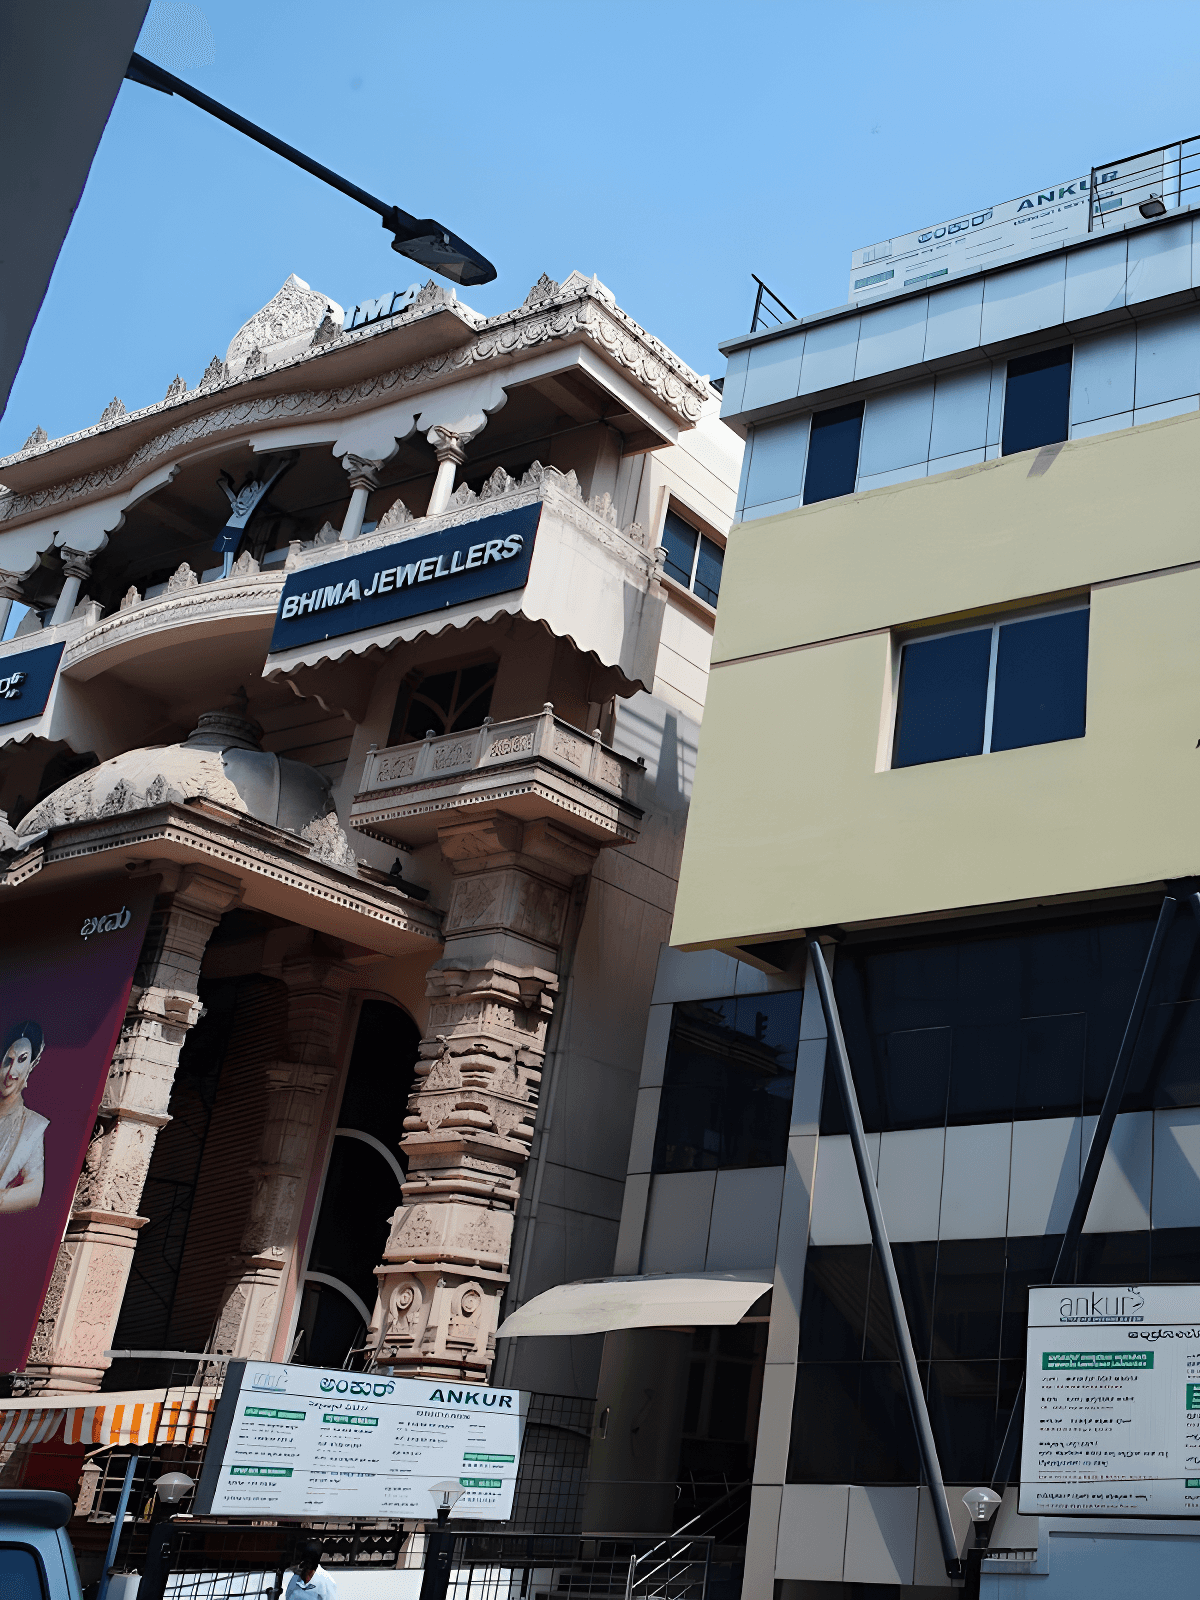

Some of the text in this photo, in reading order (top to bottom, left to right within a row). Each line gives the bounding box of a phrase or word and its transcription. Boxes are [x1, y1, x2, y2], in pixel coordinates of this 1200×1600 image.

[281, 533, 525, 619] BHIMA JEWELLERS
[1059, 1291, 1134, 1317] ankur
[429, 1389, 513, 1408] ANKUR
